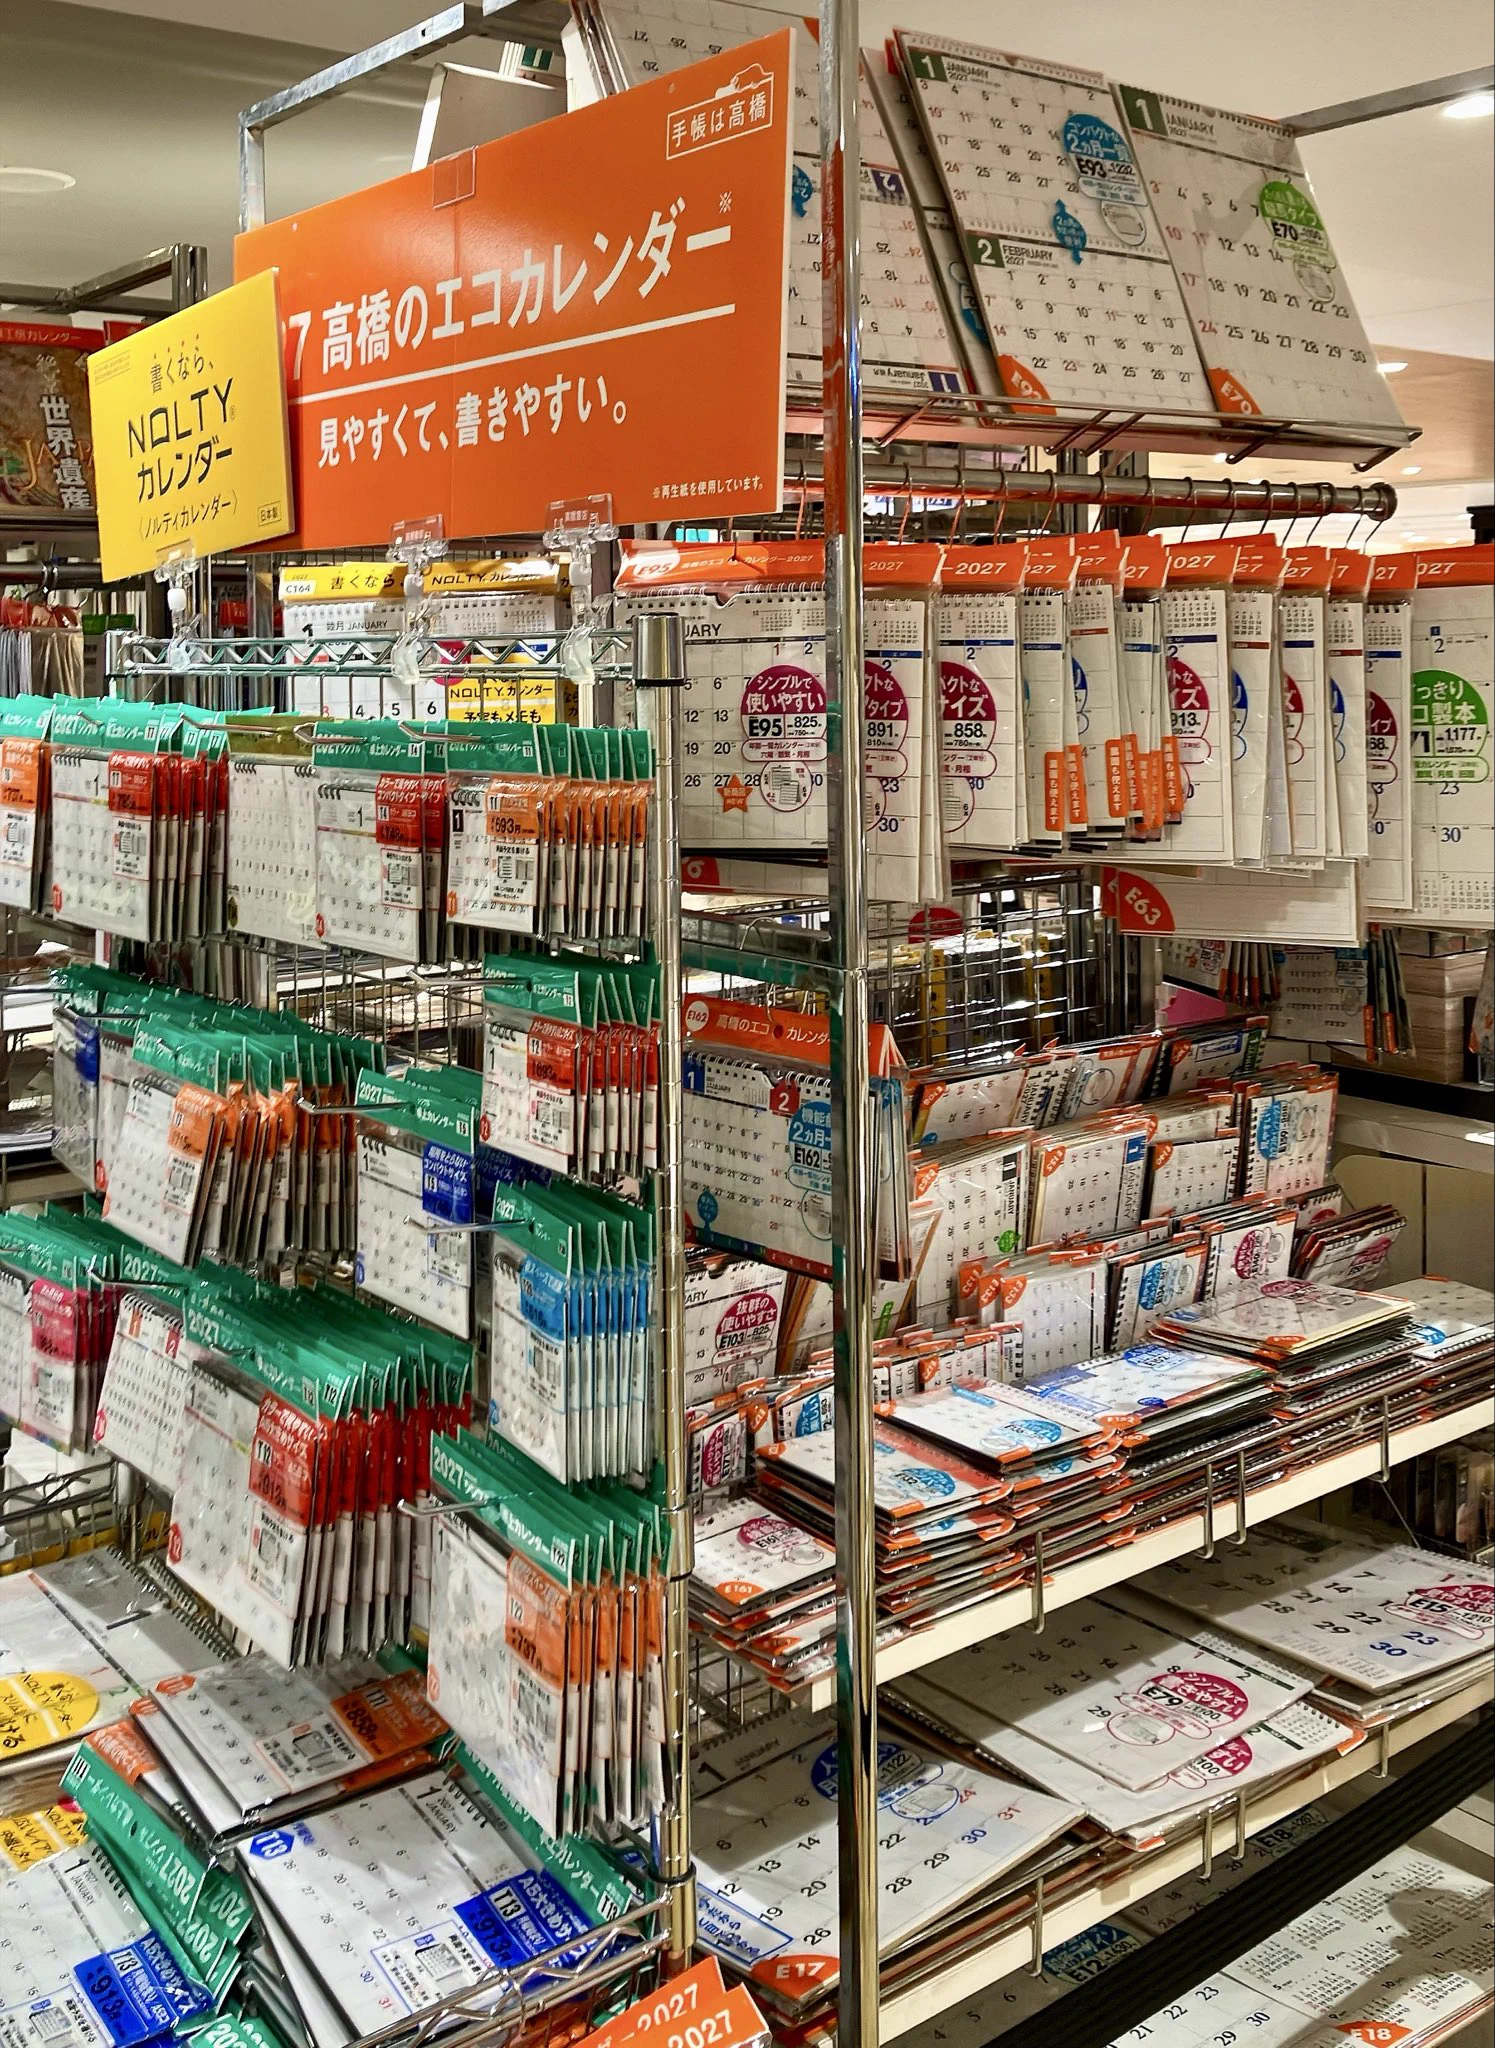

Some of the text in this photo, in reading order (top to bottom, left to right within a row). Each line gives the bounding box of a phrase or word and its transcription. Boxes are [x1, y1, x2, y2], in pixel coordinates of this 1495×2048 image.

[671, 93, 767, 149] 手帳は高橋
[1166, 112, 1215, 136] JANUARY
[1272, 218, 1300, 243] E70
[977, 238, 1053, 265] 2 FEBRUARY
[150, 340, 214, 394] 書くなら、
[1032, 357, 1048, 369] 22
[318, 374, 628, 469] 見やすくて、書きやすい。
[39, 394, 95, 511] 世界遺産
[137, 435, 233, 503] カレンダー
[259, 505, 280, 523] 日本製
[285, 583, 311, 594] C164
[347, 620, 388, 632] JANUARY
[803, 642, 814, 655] 2
[1434, 638, 1445, 653] 2
[756, 674, 813, 690] シンプルで
[355, 700, 437, 718] 4 5 6
[745, 692, 824, 714] 使いやすい
[684, 709, 729, 723] 12 13
[749, 717, 783, 738] E95
[684, 742, 731, 755] 19 20
[684, 774, 701, 787] 26
[1440, 827, 1462, 843] 30
[1124, 886, 1162, 926] E63
[687, 1009, 707, 1022] E162
[687, 1071, 695, 1090] 1
[794, 1144, 820, 1169] E162
[736, 1297, 770, 1316] 抜群の
[720, 1308, 777, 1334] 使いやすさ
[718, 1332, 744, 1350] E103
[433, 1446, 464, 1490] 2027
[1261, 1600, 1383, 1626] 28 22
[1408, 1598, 1451, 1614] E15
[1313, 1621, 1440, 1646] 29 23
[1369, 1641, 1408, 1657] 30
[1141, 1685, 1184, 1707] E79
[1184, 1672, 1247, 1705] シンプルで
[424, 1801, 457, 1834] JANUARY
[258, 1831, 290, 1859] T13
[757, 1835, 821, 1874] 13 14
[879, 1828, 988, 1895] 22 29 30 28
[493, 1888, 522, 1918] T13
[800, 1880, 832, 1946] 20 26
[113, 1950, 138, 1973] T13
[775, 1960, 826, 1980] E17
[1129, 1985, 1221, 2041] 21 22 23
[1213, 2011, 1271, 2047] 29 30
[1350, 2026, 1392, 2043] E18
